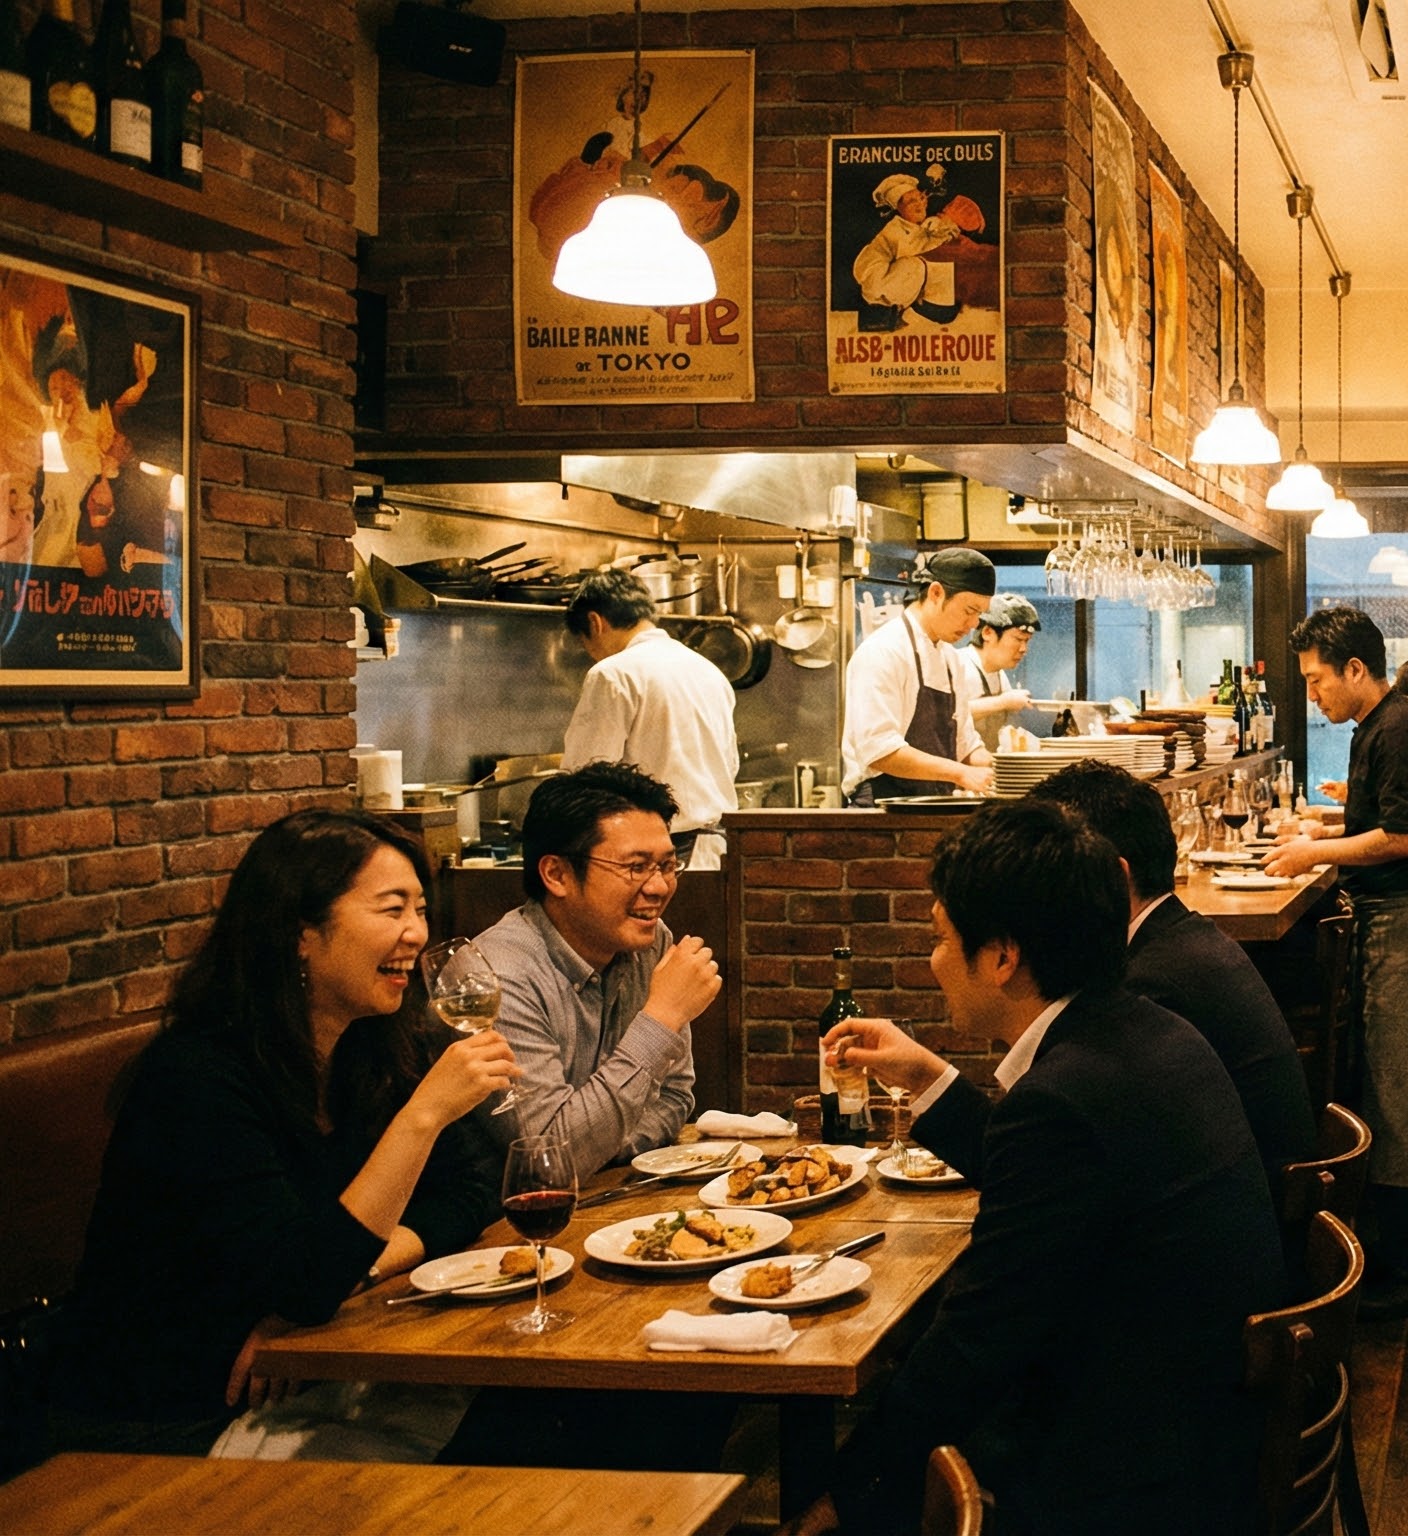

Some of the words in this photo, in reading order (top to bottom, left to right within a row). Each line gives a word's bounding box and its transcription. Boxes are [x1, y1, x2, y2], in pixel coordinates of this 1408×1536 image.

[839, 146, 922, 164] BRANCUSE
[584, 325, 649, 347] RANNE
[597, 352, 691, 371] TOKYO
